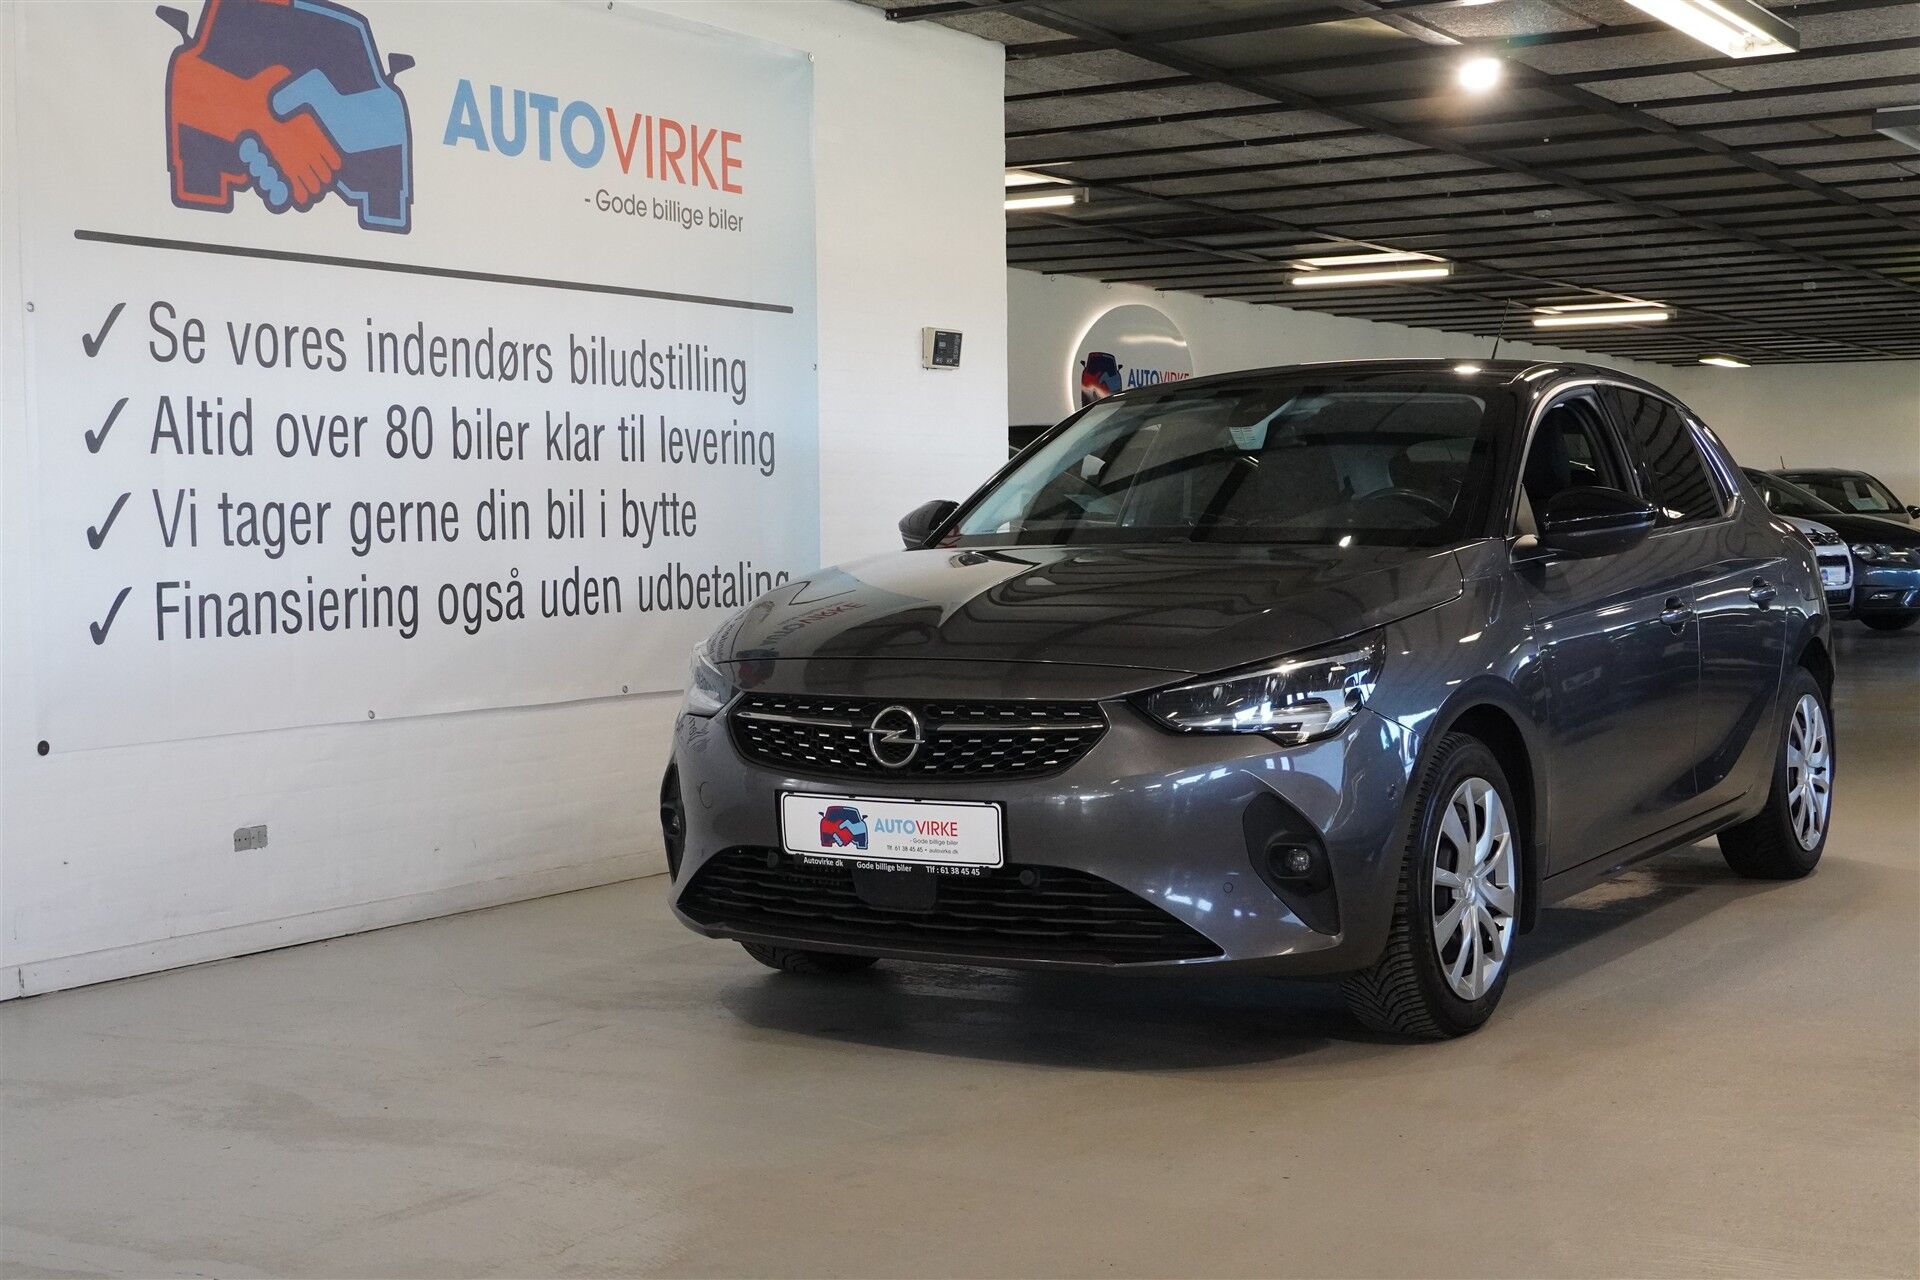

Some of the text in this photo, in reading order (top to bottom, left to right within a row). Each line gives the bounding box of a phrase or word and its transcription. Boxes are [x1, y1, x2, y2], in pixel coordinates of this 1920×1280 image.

[442, 78, 743, 195] AUTOVIRKE
[595, 189, 647, 217] Gode
[652, 197, 704, 230] billige
[708, 207, 744, 233] biler
[150, 301, 747, 405] Se vores indendørs biludstilling
[151, 396, 775, 477] Altid over 80 biler klar til levering
[153, 489, 697, 560] Vi tager gerne din bil i bytte
[157, 574, 419, 641] Finansiering
[438, 566, 526, 636] også
[542, 566, 622, 619] uden
[874, 818, 958, 837] AUTOVIRKE
[912, 837, 928, 845] Gode
[856, 861, 874, 870] Gode
[875, 862, 895, 873] billige
[896, 864, 912, 873] biler
[950, 867, 960, 875] 38
[960, 867, 970, 876] 45
[970, 868, 980, 876] 45
